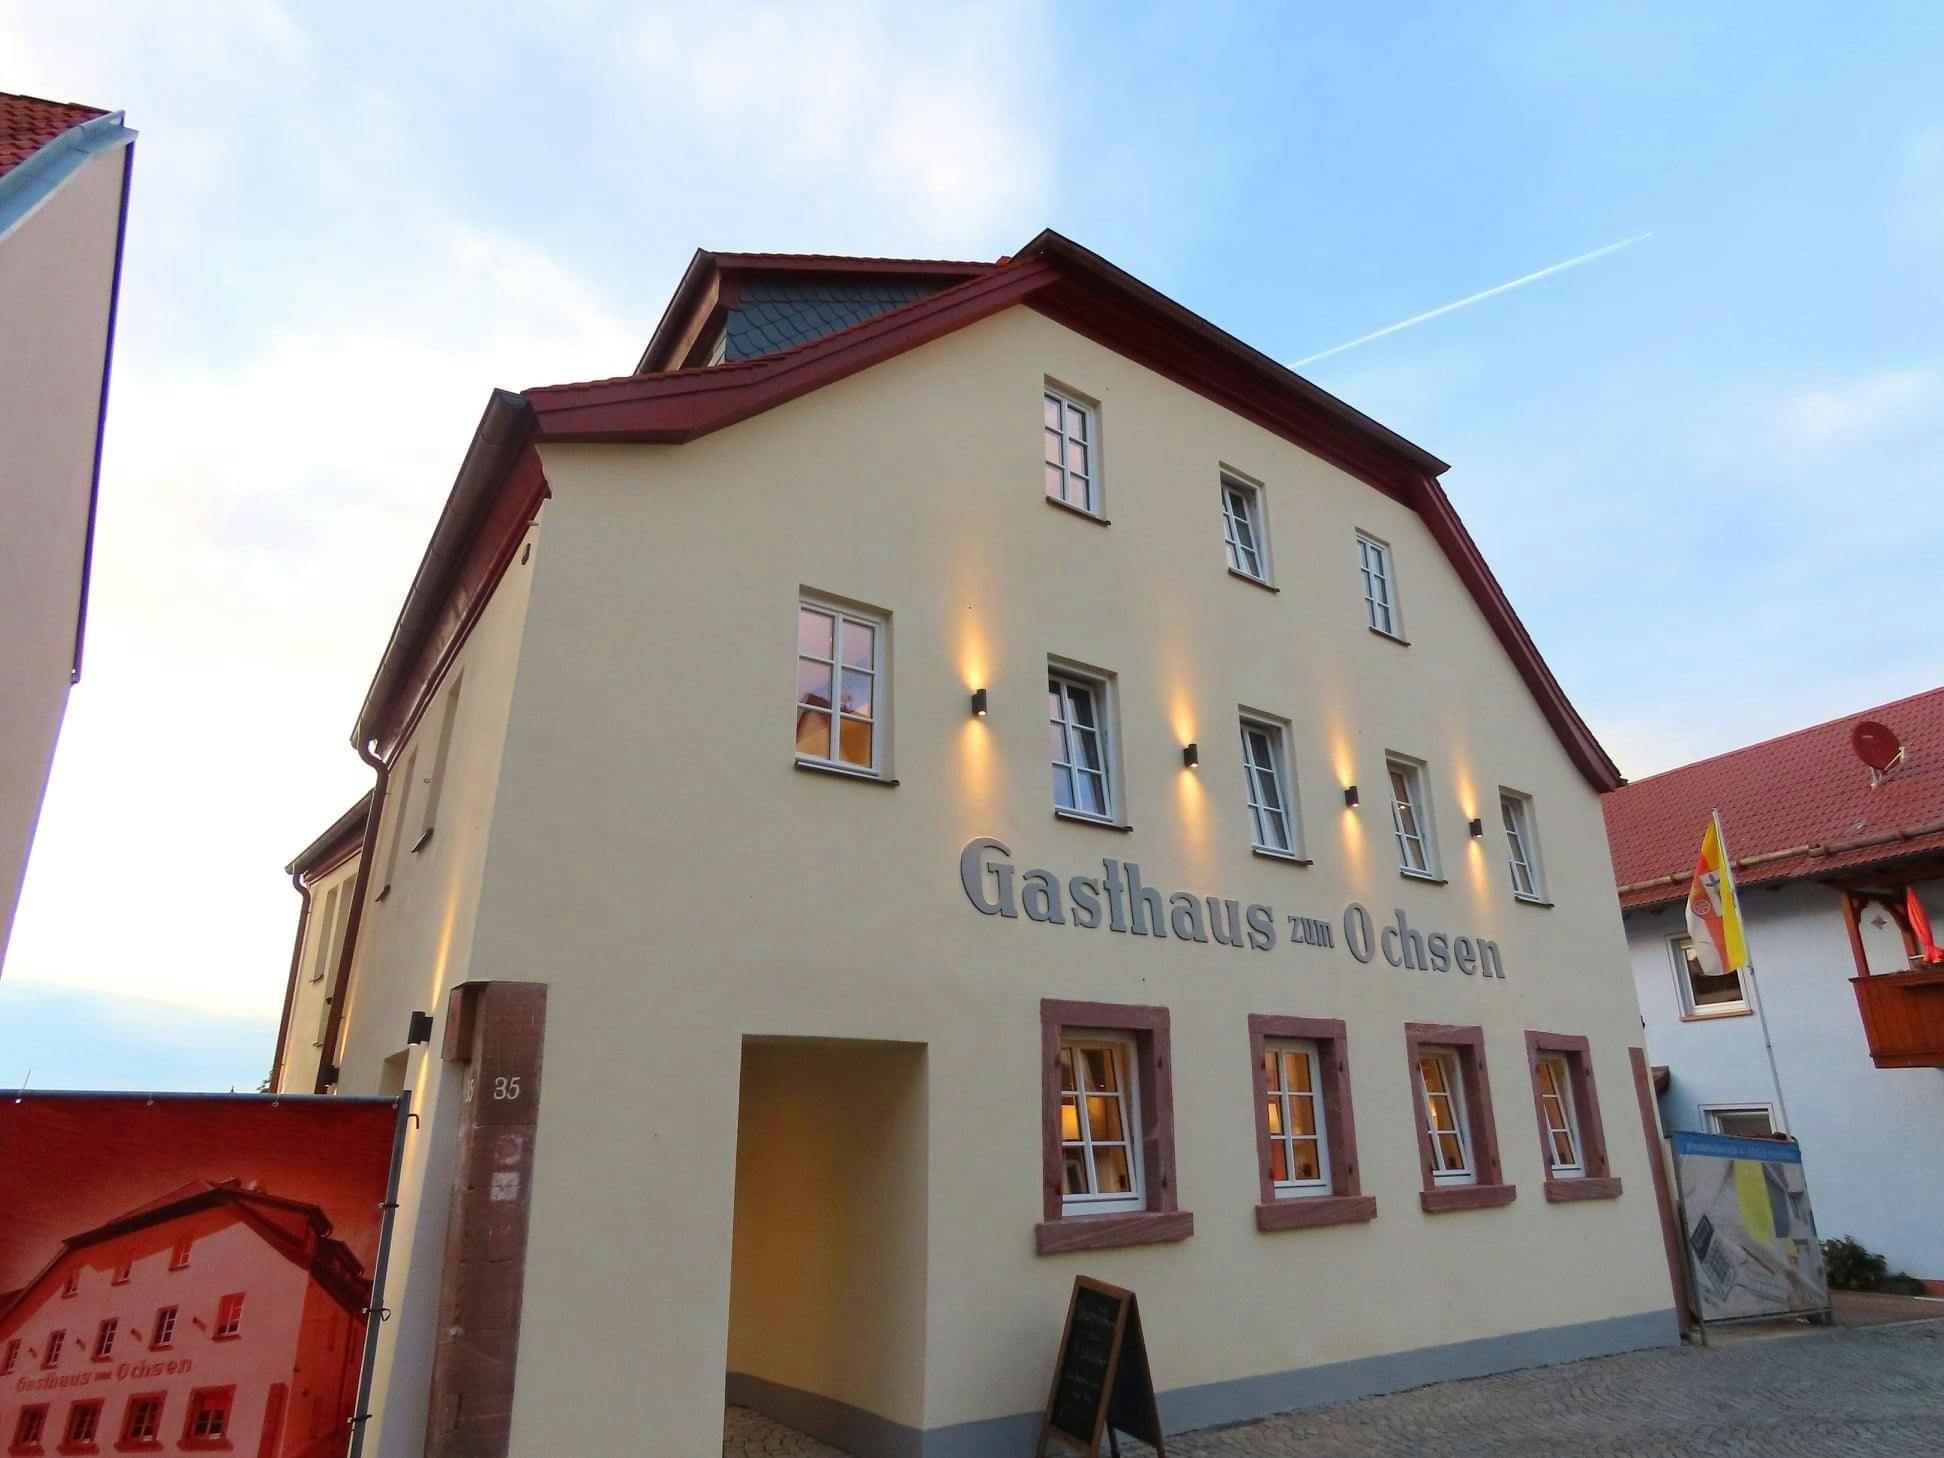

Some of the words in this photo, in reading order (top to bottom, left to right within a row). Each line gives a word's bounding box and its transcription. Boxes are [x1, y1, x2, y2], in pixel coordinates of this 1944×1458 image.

[960, 837, 1275, 951] Gasthaus
[1287, 915, 1335, 948] zum
[1343, 902, 1506, 978] Ochsen
[493, 1077, 521, 1100] 35
[117, 1358, 193, 1382] Ochsen
